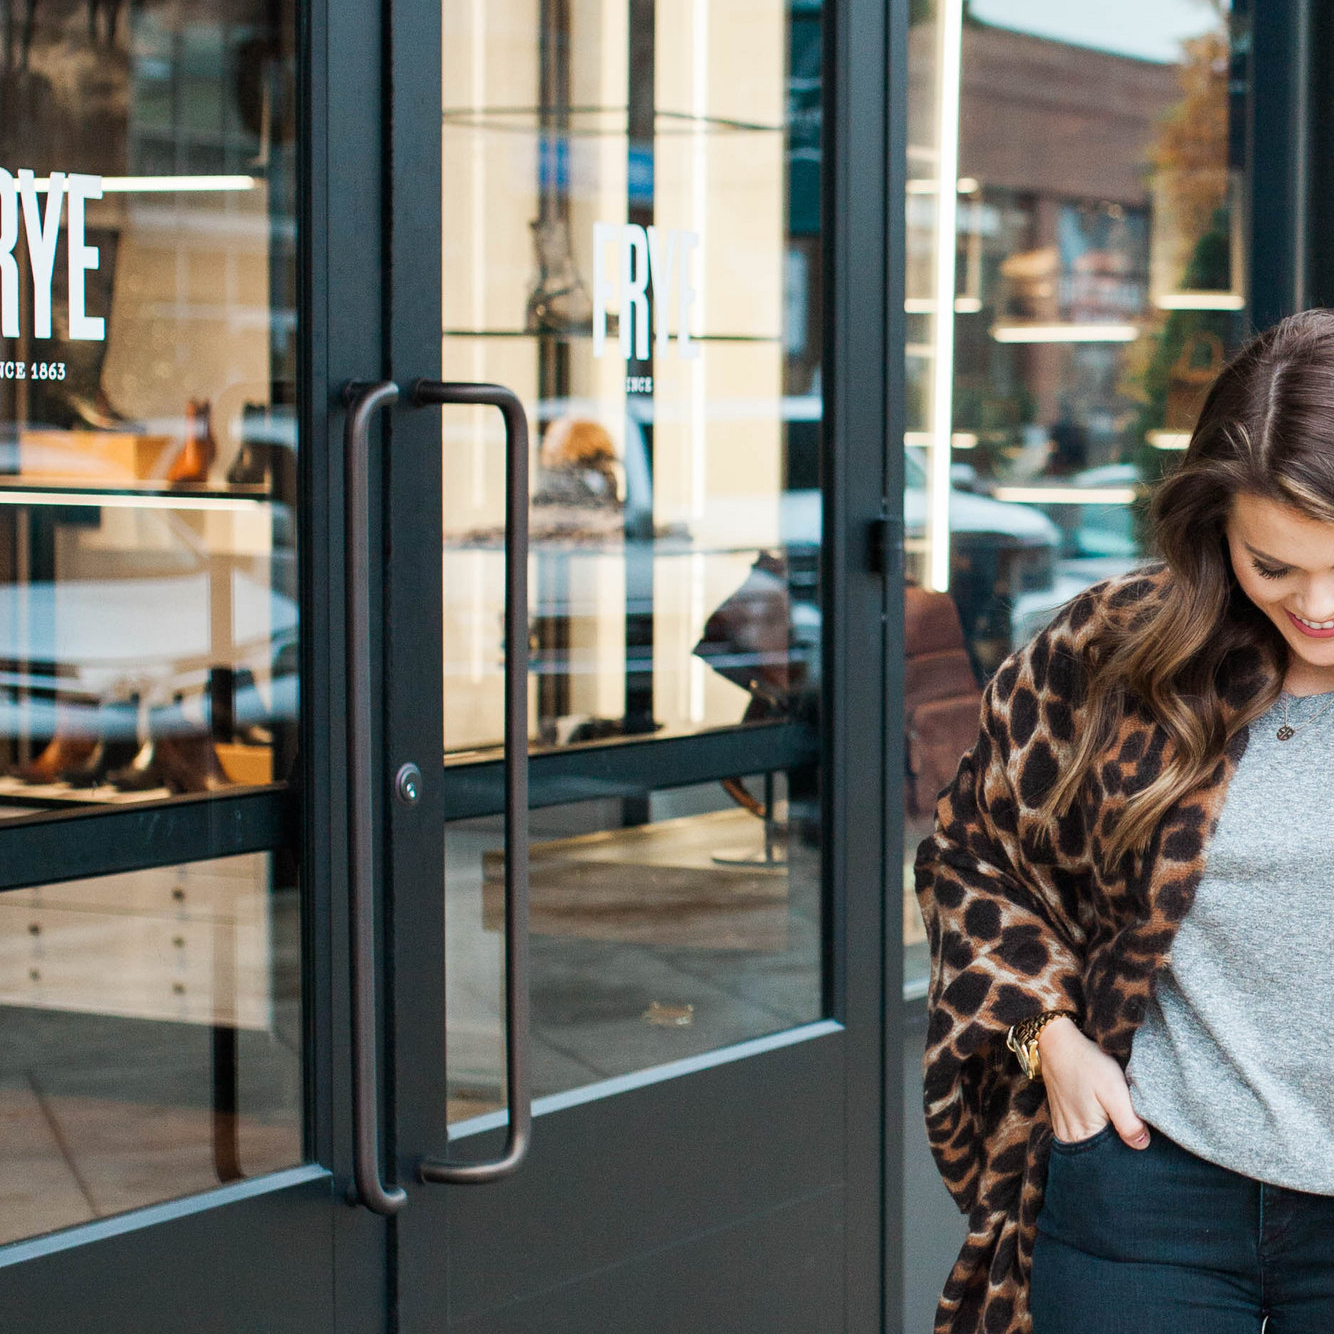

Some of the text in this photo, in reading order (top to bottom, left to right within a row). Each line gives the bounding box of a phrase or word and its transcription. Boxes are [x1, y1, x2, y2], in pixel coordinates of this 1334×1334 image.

[0, 167, 106, 341] RYE
[592, 221, 699, 361] FRYE
[31, 361, 66, 381] 1863
[626, 376, 653, 393] INCE
